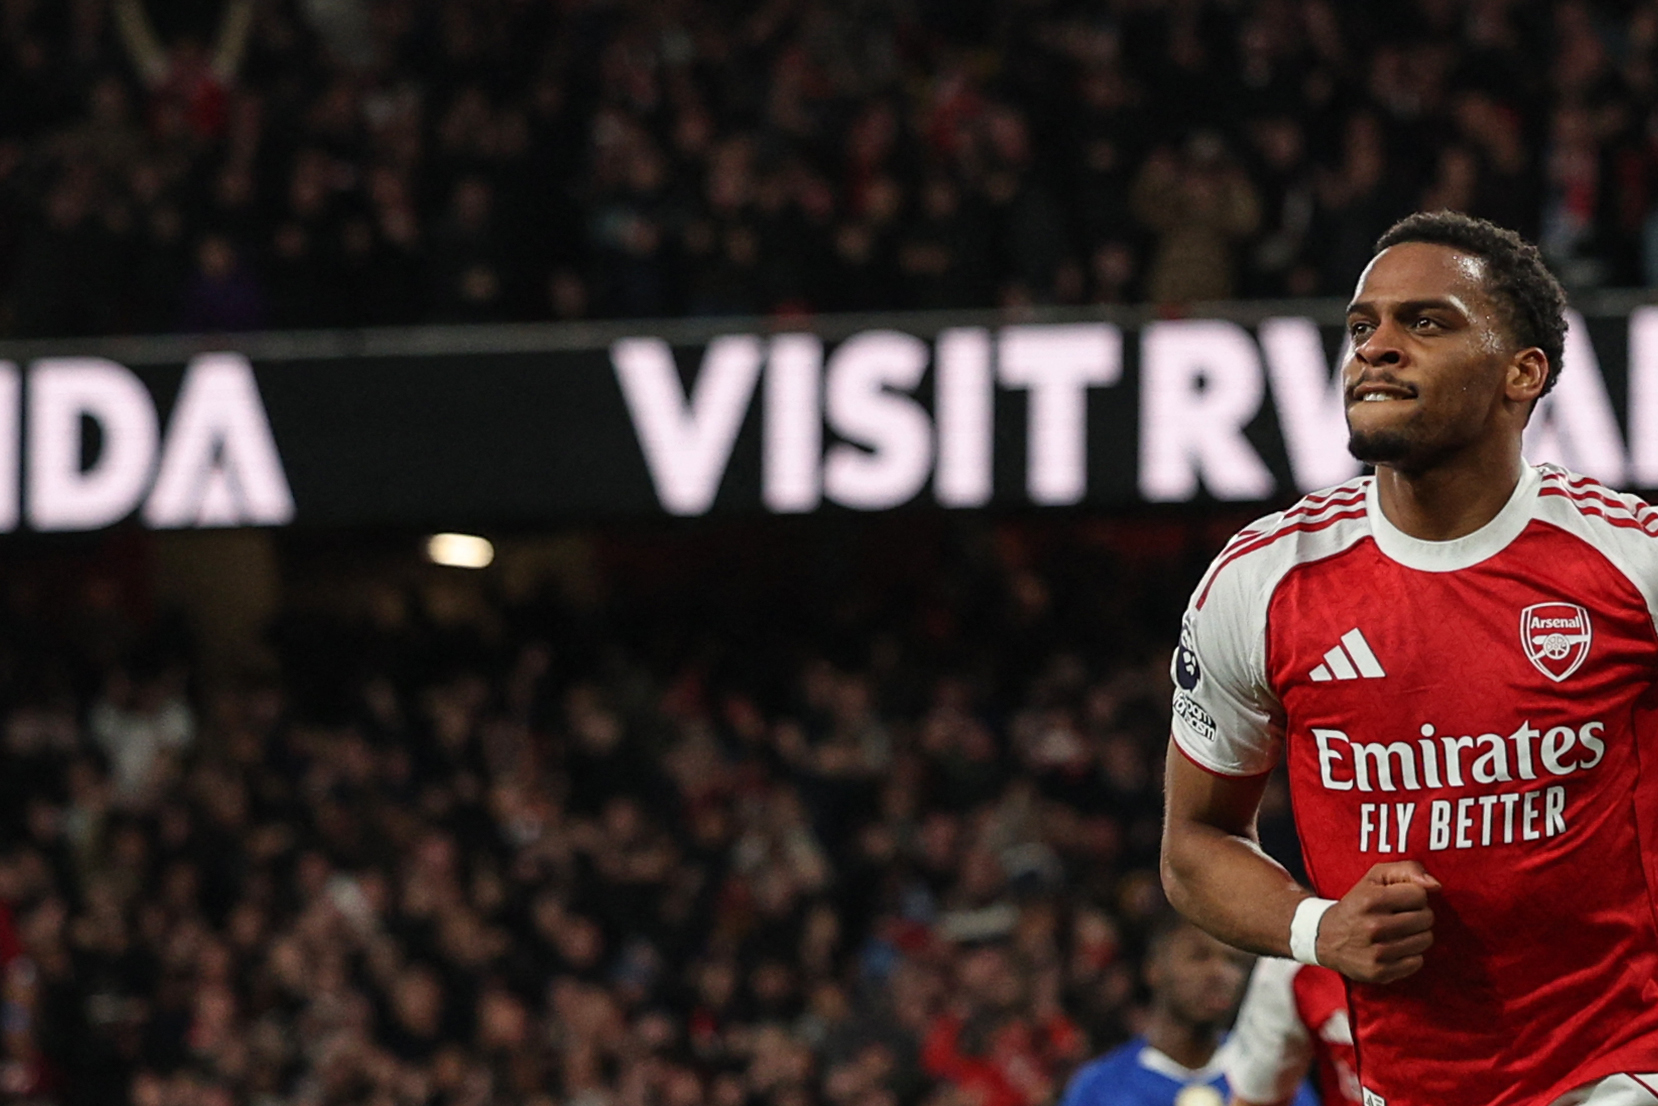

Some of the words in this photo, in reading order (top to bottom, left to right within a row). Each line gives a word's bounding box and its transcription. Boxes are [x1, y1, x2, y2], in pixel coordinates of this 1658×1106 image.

[0, 352, 296, 532] DA
[613, 326, 1122, 513] VISIT
[1531, 616, 1581, 629] Arsenal
[1311, 720, 1605, 792] Emirates
[1359, 803, 1415, 853] FLY
[1429, 785, 1567, 850] BETTER
